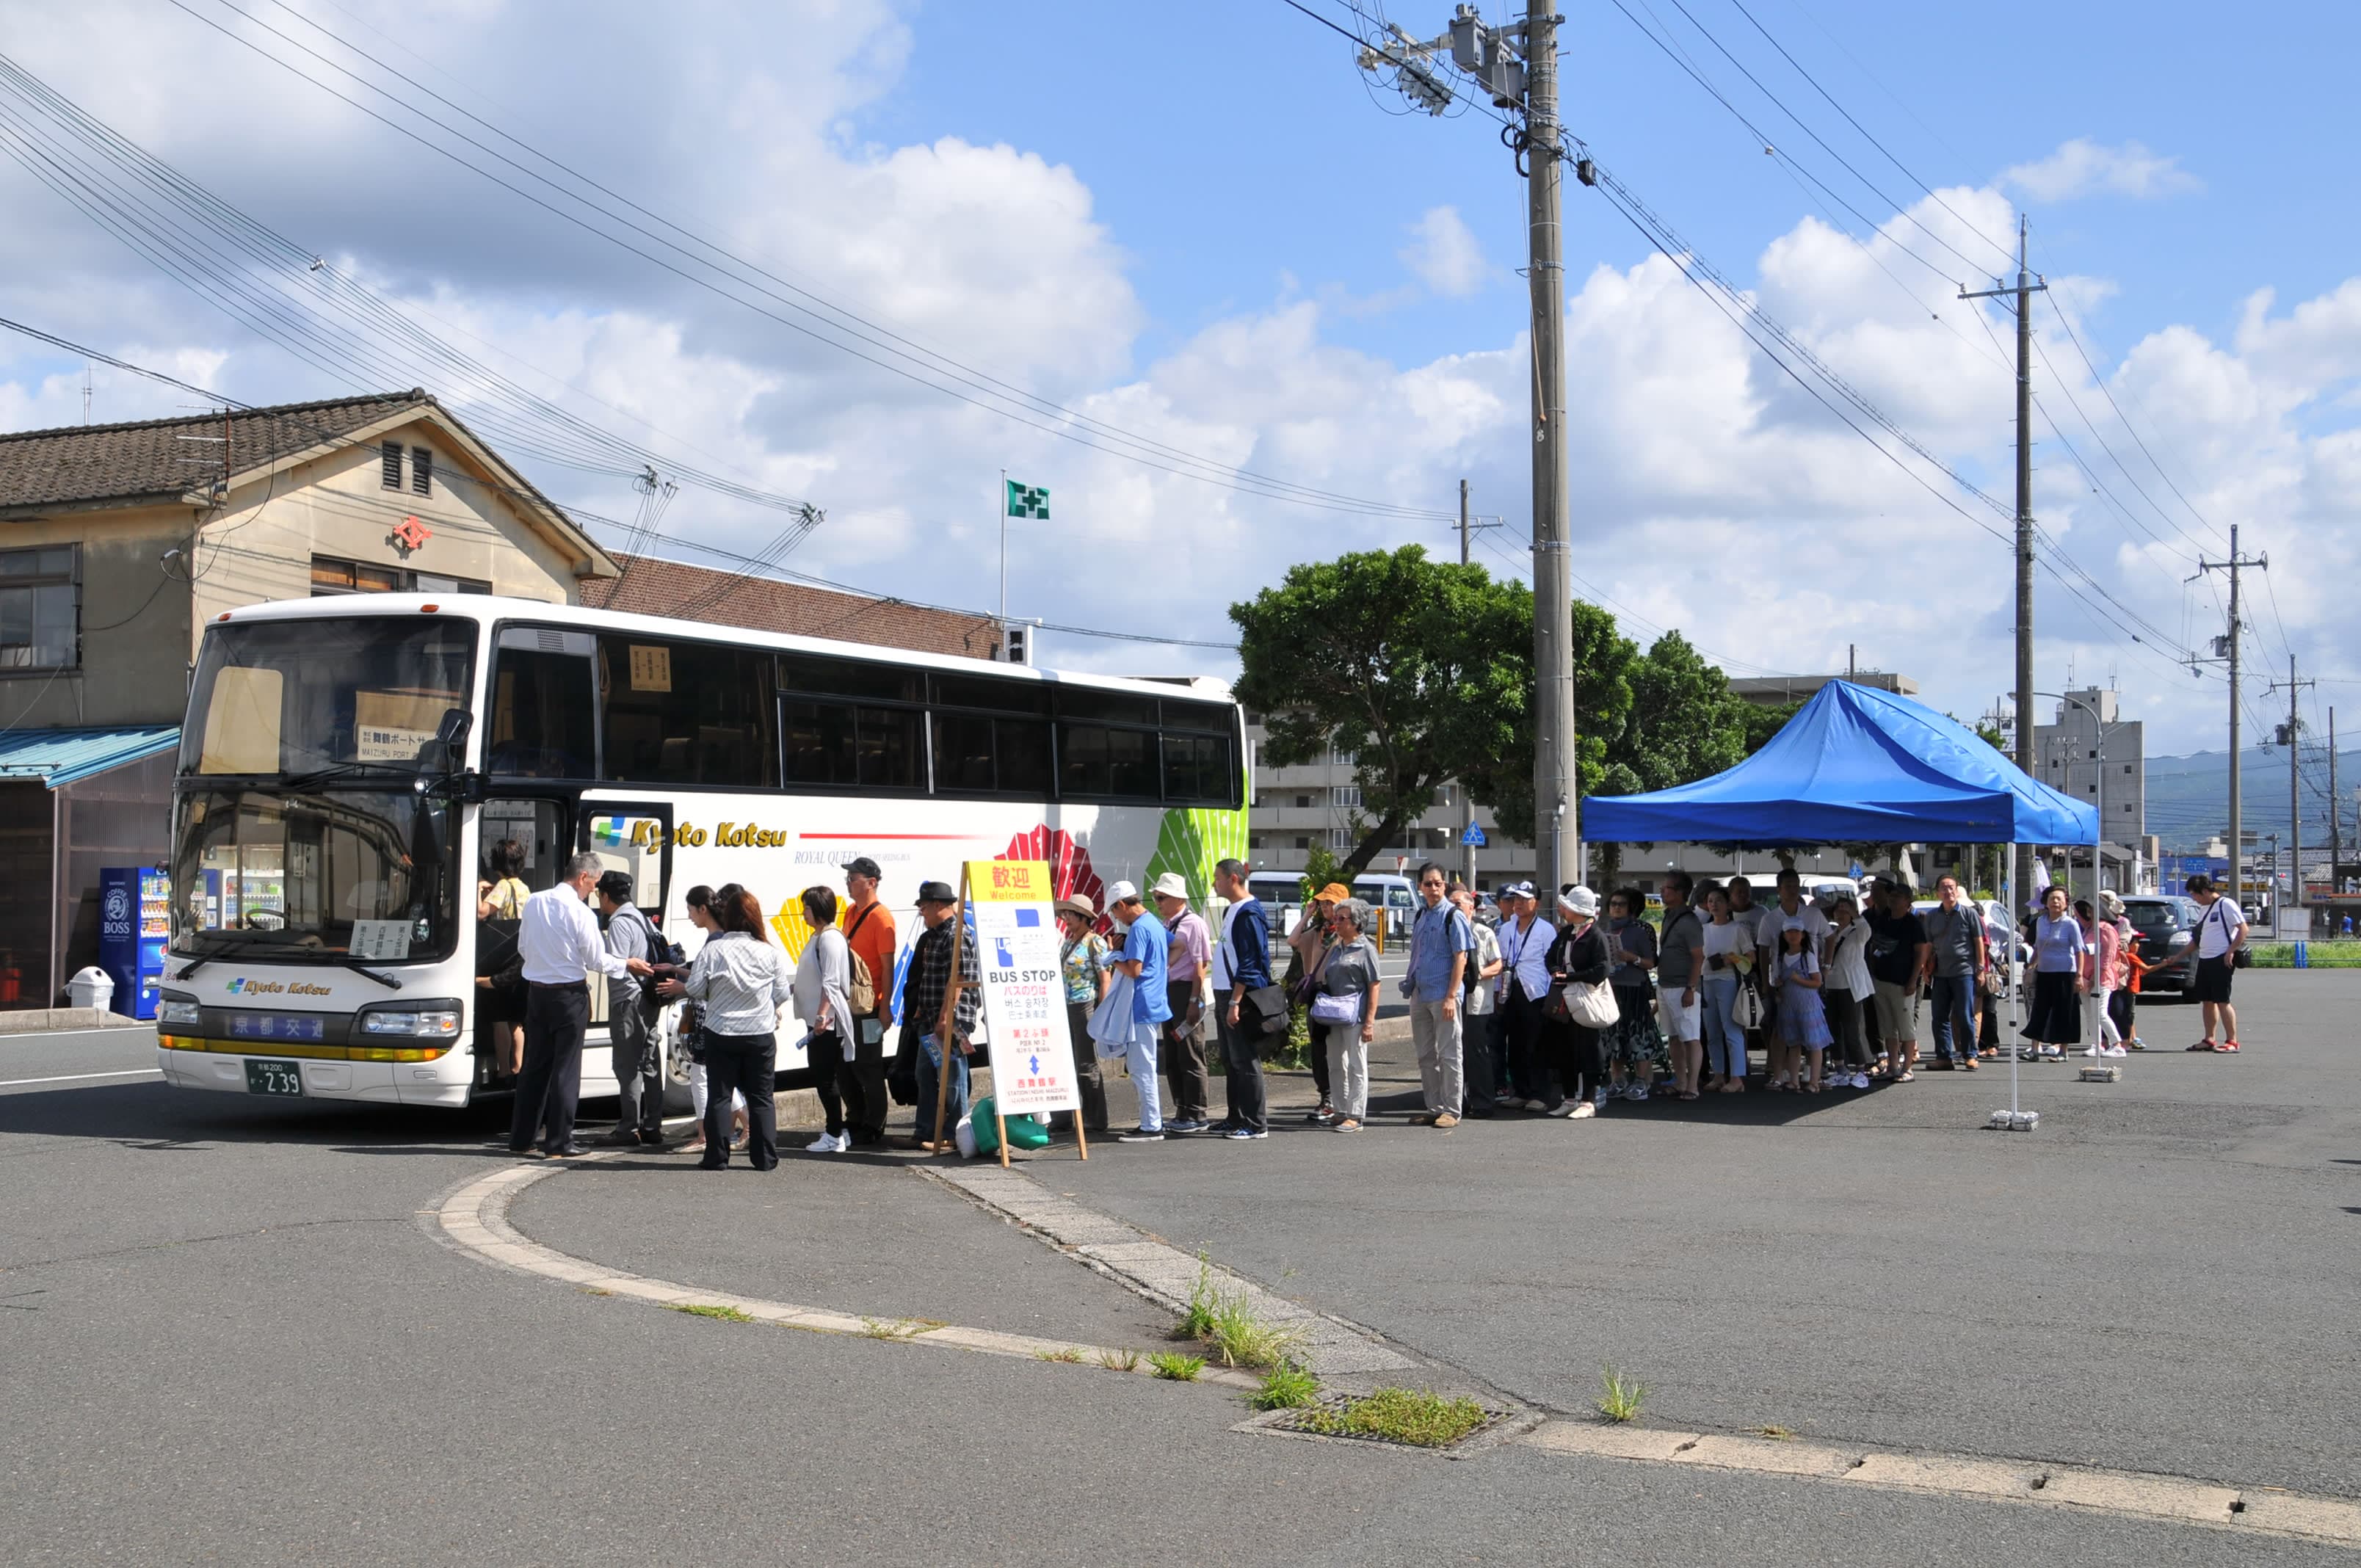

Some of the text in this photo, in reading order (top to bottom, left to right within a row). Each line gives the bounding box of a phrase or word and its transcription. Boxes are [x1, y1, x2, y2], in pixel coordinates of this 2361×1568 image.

[362, 747, 391, 758] MAIZURU
[393, 750, 409, 758] PORT
[714, 821, 787, 848] Kotsu
[794, 851, 860, 867] ROYAL QUEEN
[992, 865, 1031, 889] 歓迎
[106, 888, 128, 899] COFFEE
[990, 890, 1037, 900] Welcome
[104, 921, 130, 934] BOSS
[165, 971, 181, 982] 84
[990, 970, 1056, 983] BUS STOP
[244, 980, 332, 995] Kyoto Kotsu
[1004, 986, 1047, 996] バスのりば
[1004, 998, 1048, 1009] 버스 승차장
[235, 1016, 323, 1038] 京都交通
